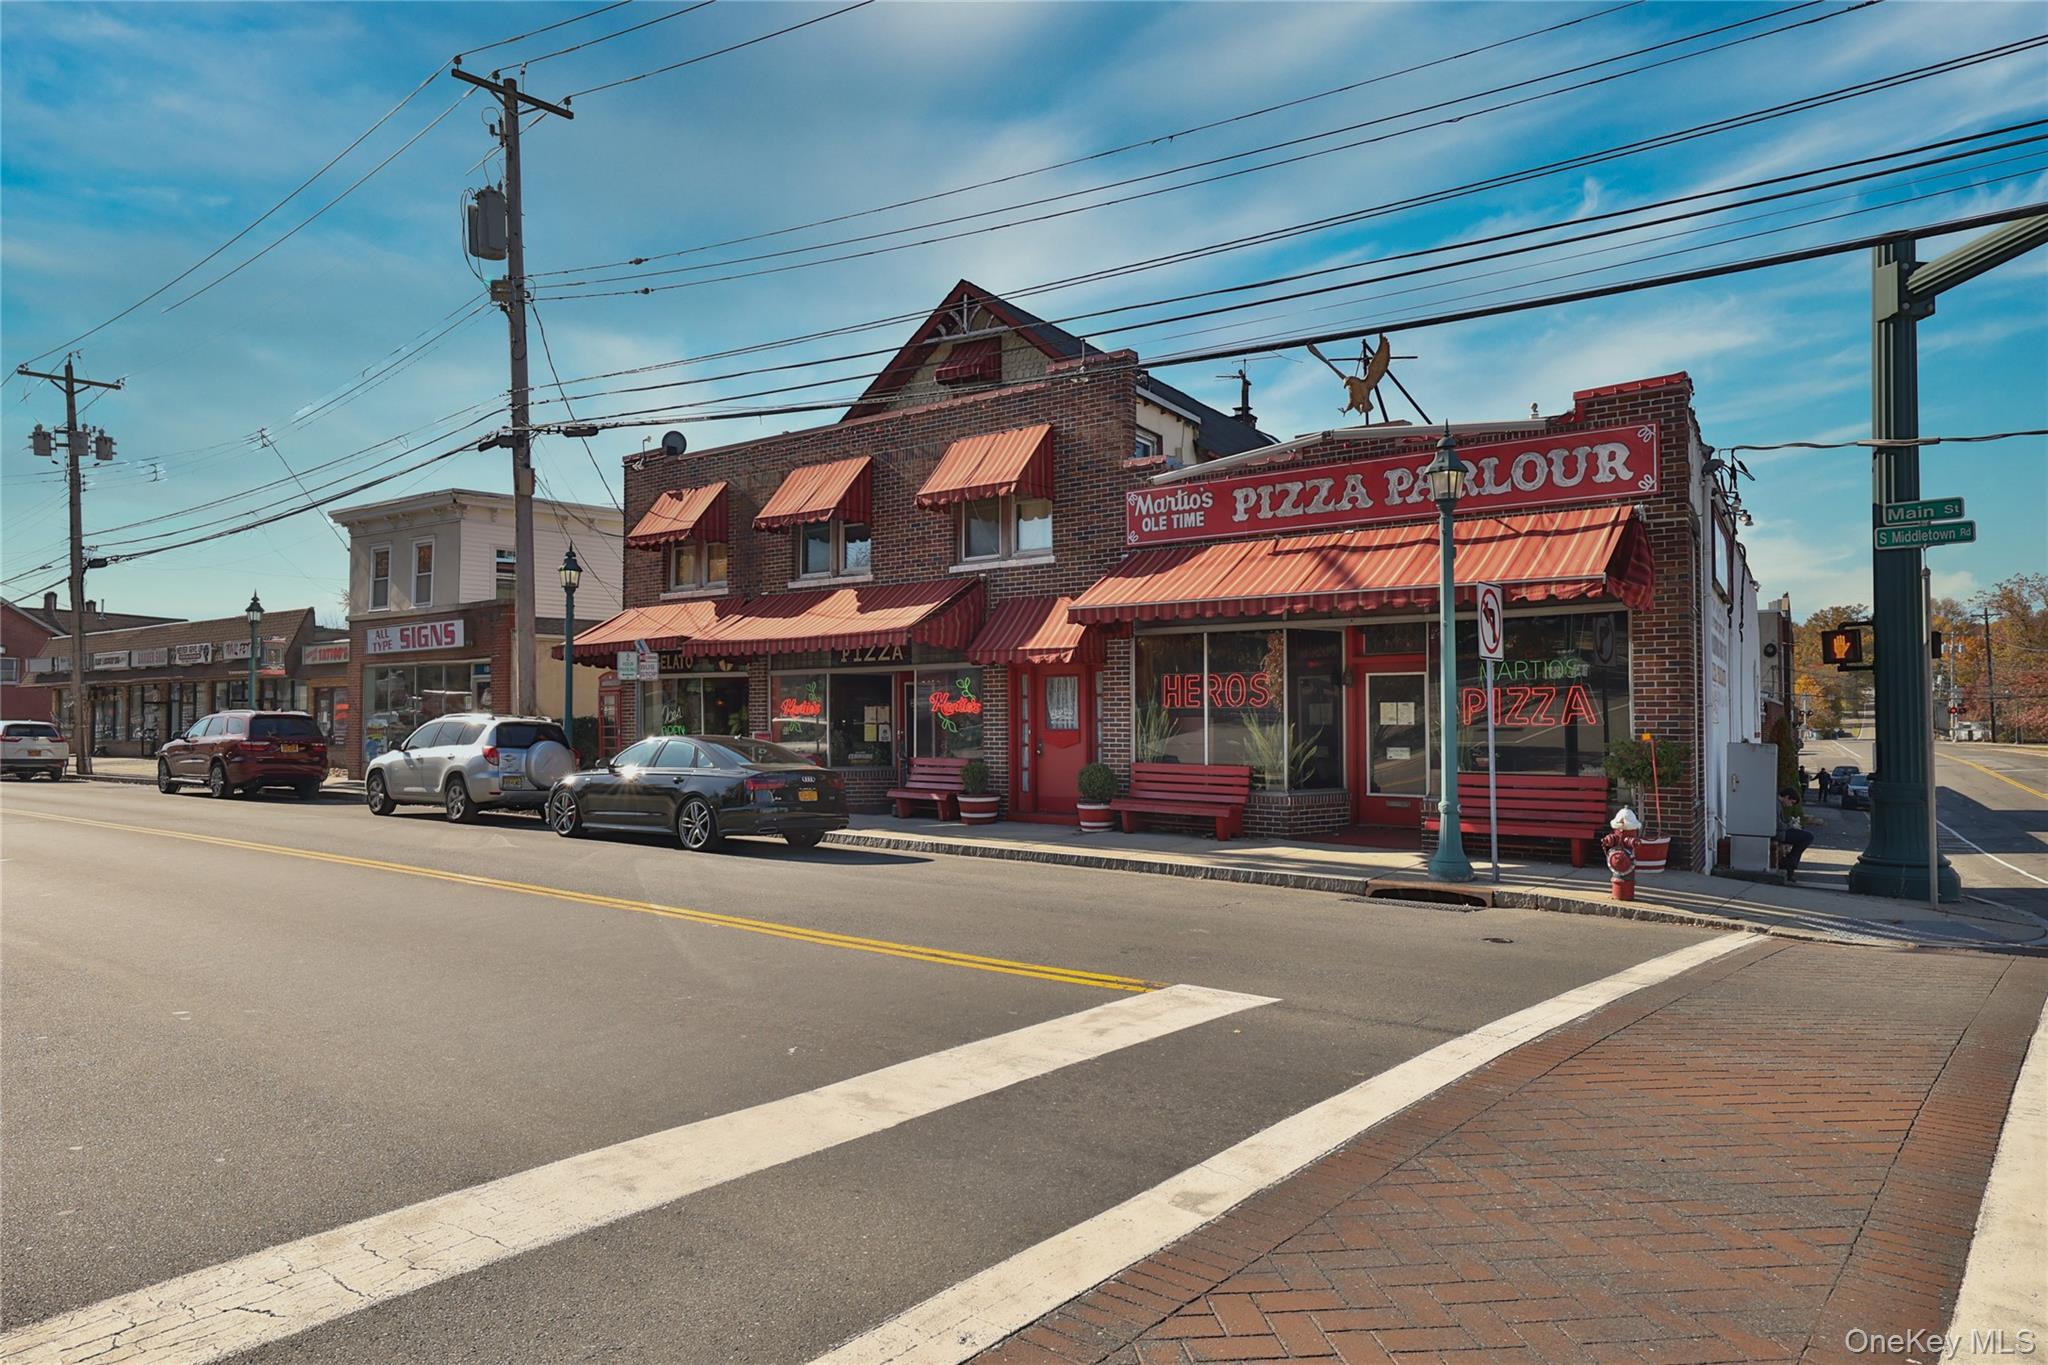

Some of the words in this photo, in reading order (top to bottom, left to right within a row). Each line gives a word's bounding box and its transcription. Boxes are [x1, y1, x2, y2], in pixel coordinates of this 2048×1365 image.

[1135, 487, 1214, 516] Martio's
[1232, 473, 1374, 522] PIZZA
[1142, 516, 1167, 532] OLE
[1172, 511, 1205, 529] TIME
[1888, 506, 1935, 520] Main
[1944, 504, 1960, 514] St
[1880, 532, 1887, 544] S
[1892, 529, 1956, 543] Middletown
[1960, 527, 1971, 536] Rd
[375, 628, 389, 639] ALL
[400, 623, 455, 649] SIGNS
[373, 640, 393, 652] TYPE
[840, 645, 904, 662] PIZZA
[660, 654, 694, 669] ELATO
[1162, 673, 1270, 708] HEROS
[1462, 685, 1597, 726] PIZZA
